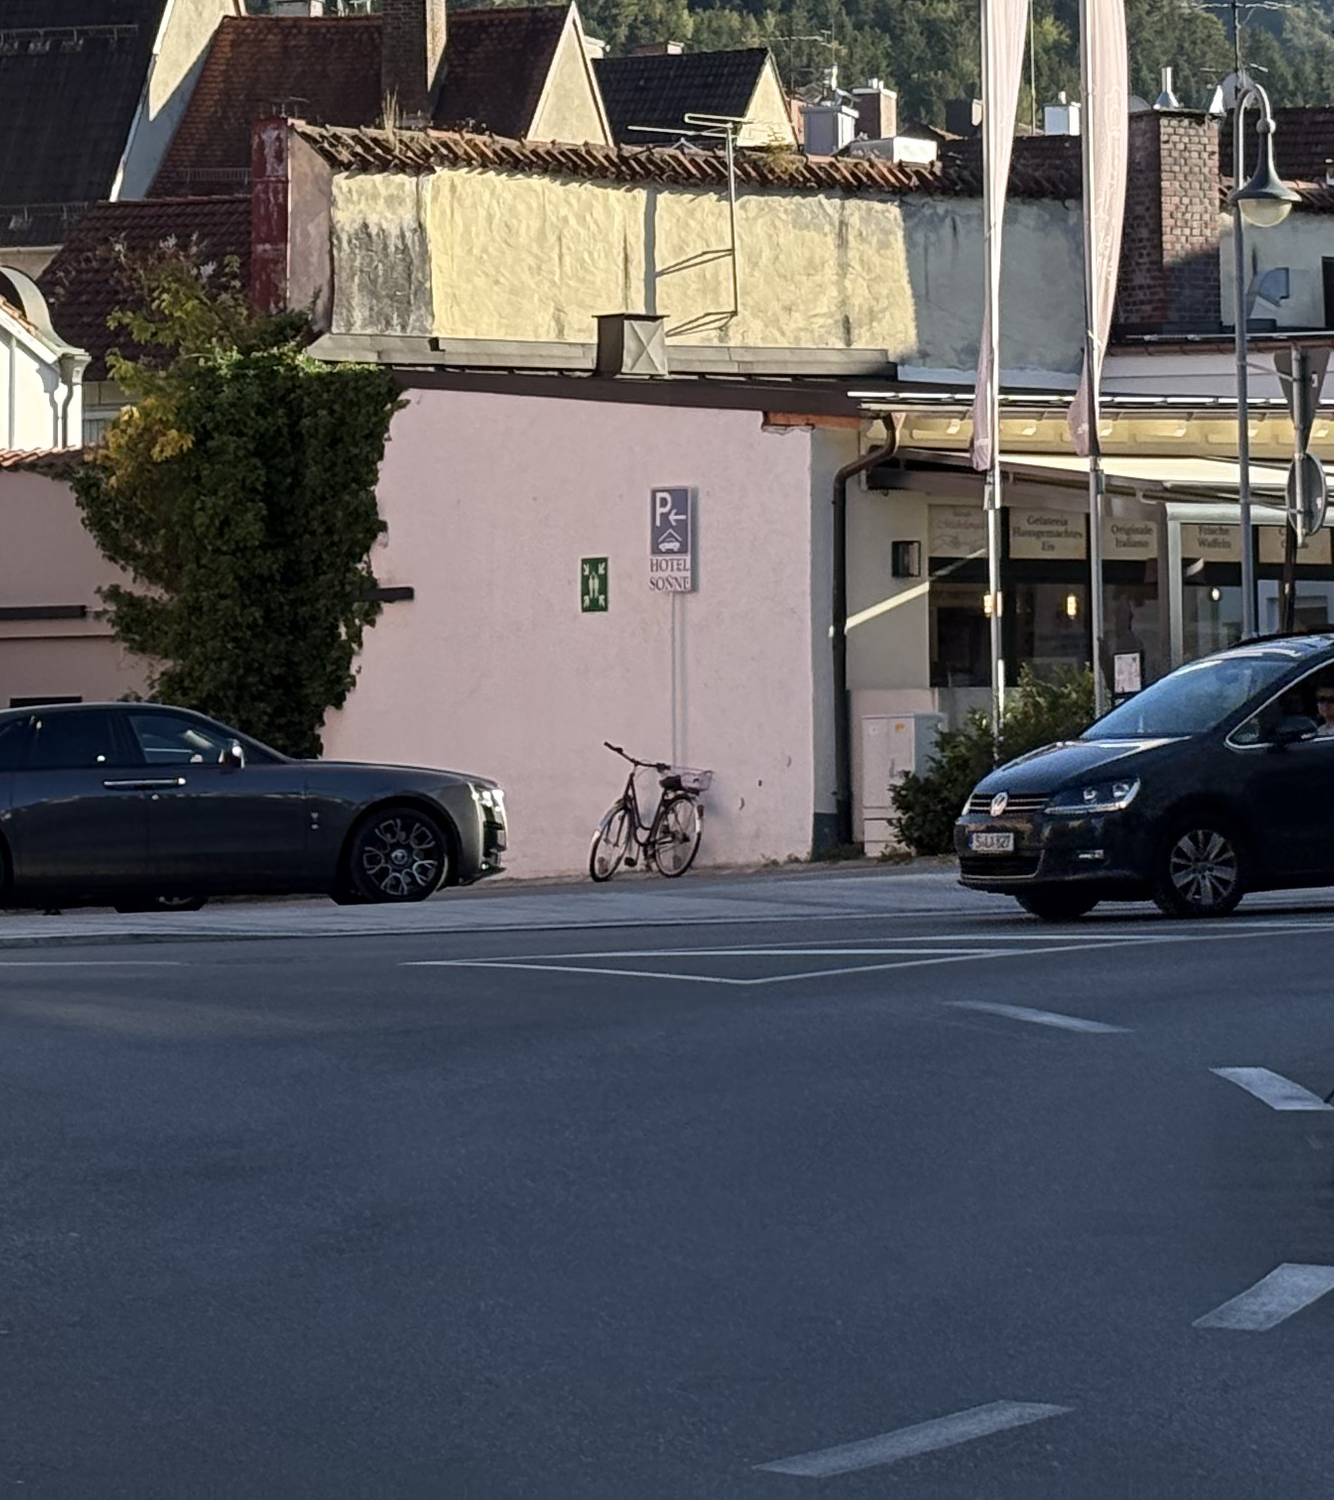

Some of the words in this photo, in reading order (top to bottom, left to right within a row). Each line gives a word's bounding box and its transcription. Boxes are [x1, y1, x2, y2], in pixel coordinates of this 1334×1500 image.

[655, 492, 672, 527] P
[650, 558, 690, 572] HOTEL
[649, 576, 690, 591] SONNE
